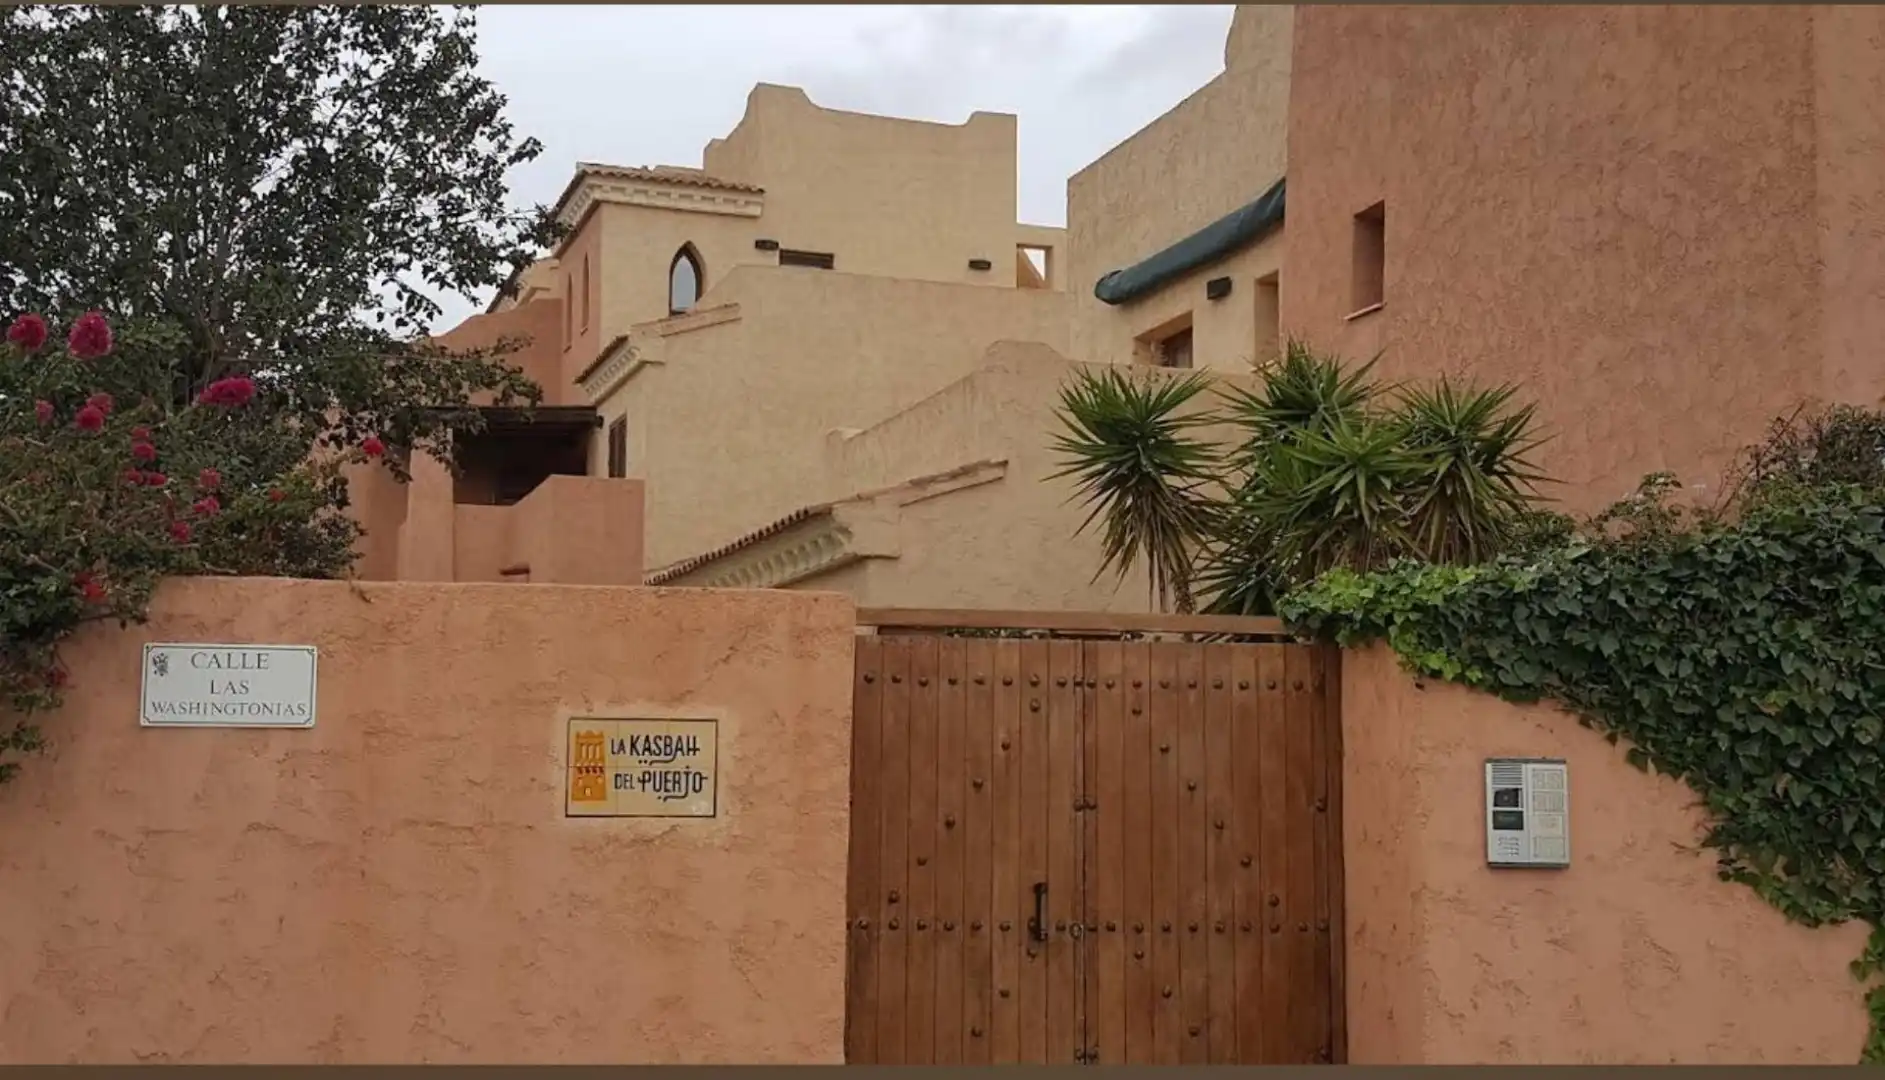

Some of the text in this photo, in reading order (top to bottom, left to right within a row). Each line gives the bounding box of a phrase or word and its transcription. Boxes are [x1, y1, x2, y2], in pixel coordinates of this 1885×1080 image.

[190, 652, 270, 670] CALLE
[210, 679, 250, 695] LAS
[151, 701, 307, 717] WASHINGTONIAS
[611, 734, 700, 765] LA KASBAH
[614, 766, 708, 802] DEL PUERTO
